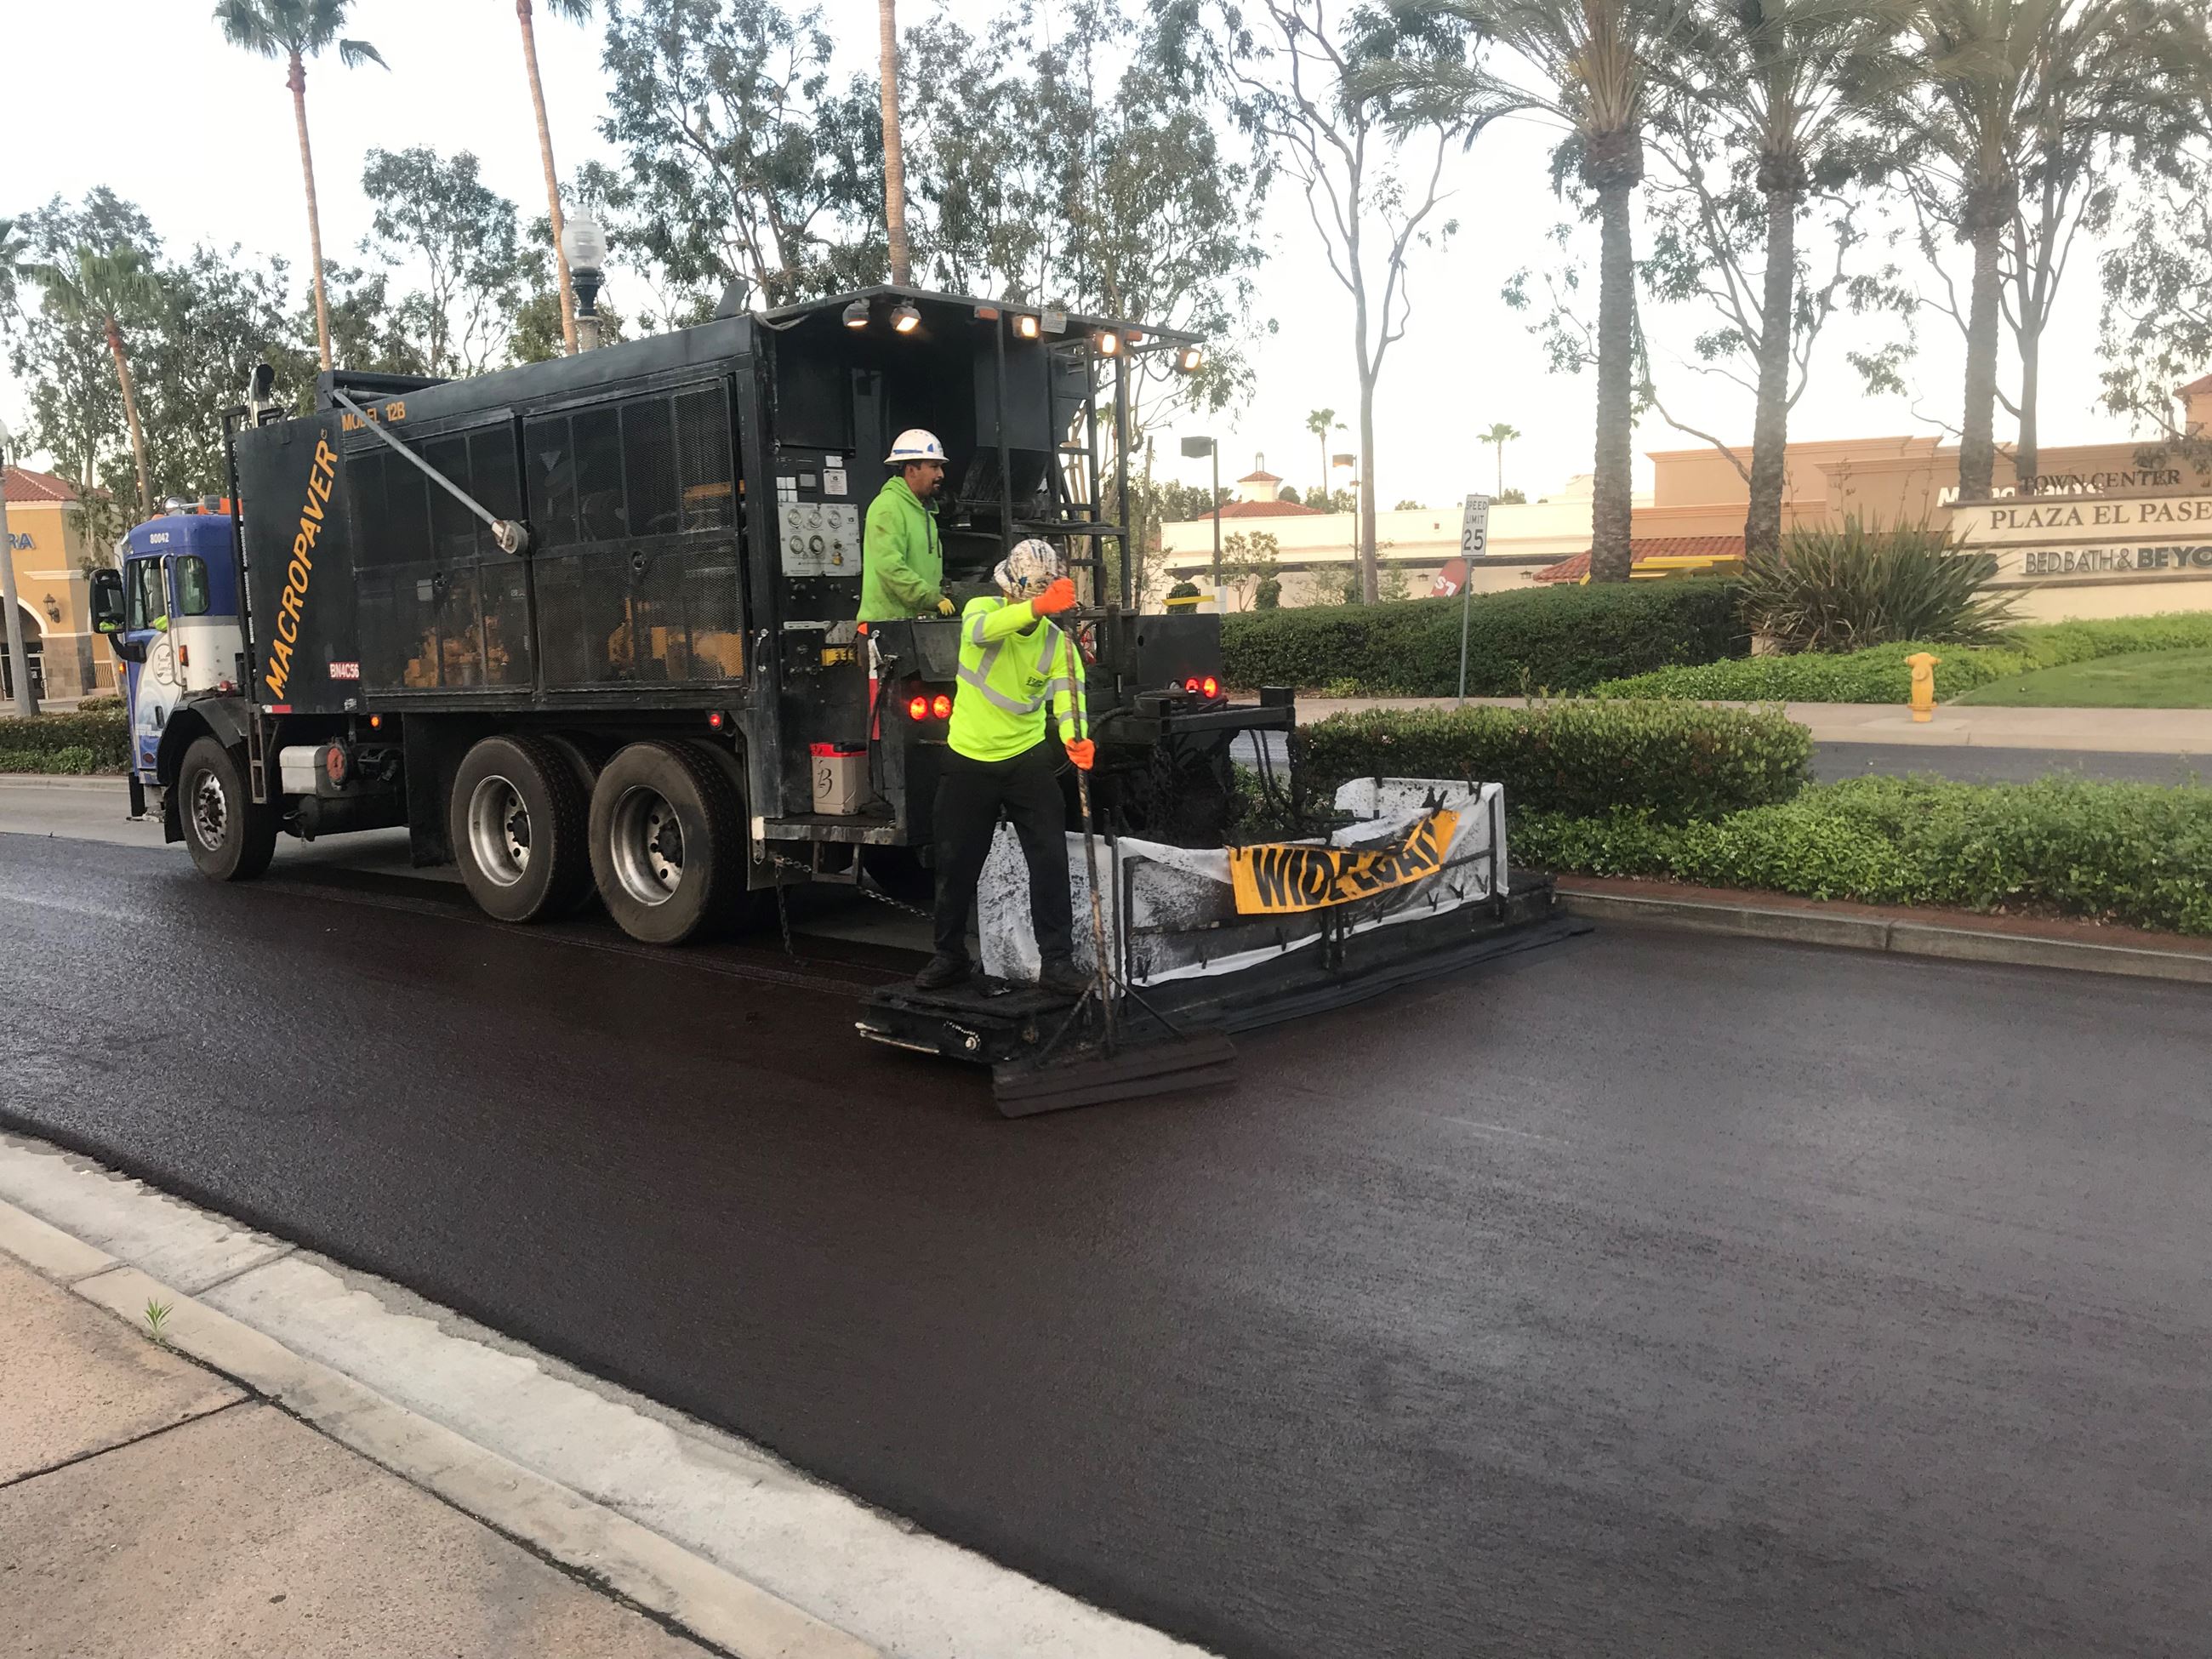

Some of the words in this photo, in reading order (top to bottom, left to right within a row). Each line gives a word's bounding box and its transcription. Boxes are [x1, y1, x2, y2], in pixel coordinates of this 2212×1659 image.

[385, 401, 406, 422] 12B
[2021, 473, 2086, 493] TOWN
[2091, 469, 2181, 488] CENTER
[1466, 500, 1487, 510] SPEED
[1990, 506, 2084, 529] PLAZA
[2092, 505, 2130, 524] EL
[1466, 515, 1485, 524] LIMIT
[1463, 528, 1484, 550] 25
[265, 440, 338, 700] MACROPAVER
[2026, 551, 2061, 573] BED
[2064, 549, 2113, 572] BATH
[2117, 548, 2133, 569] &
[1252, 847, 1359, 907] WIDE
